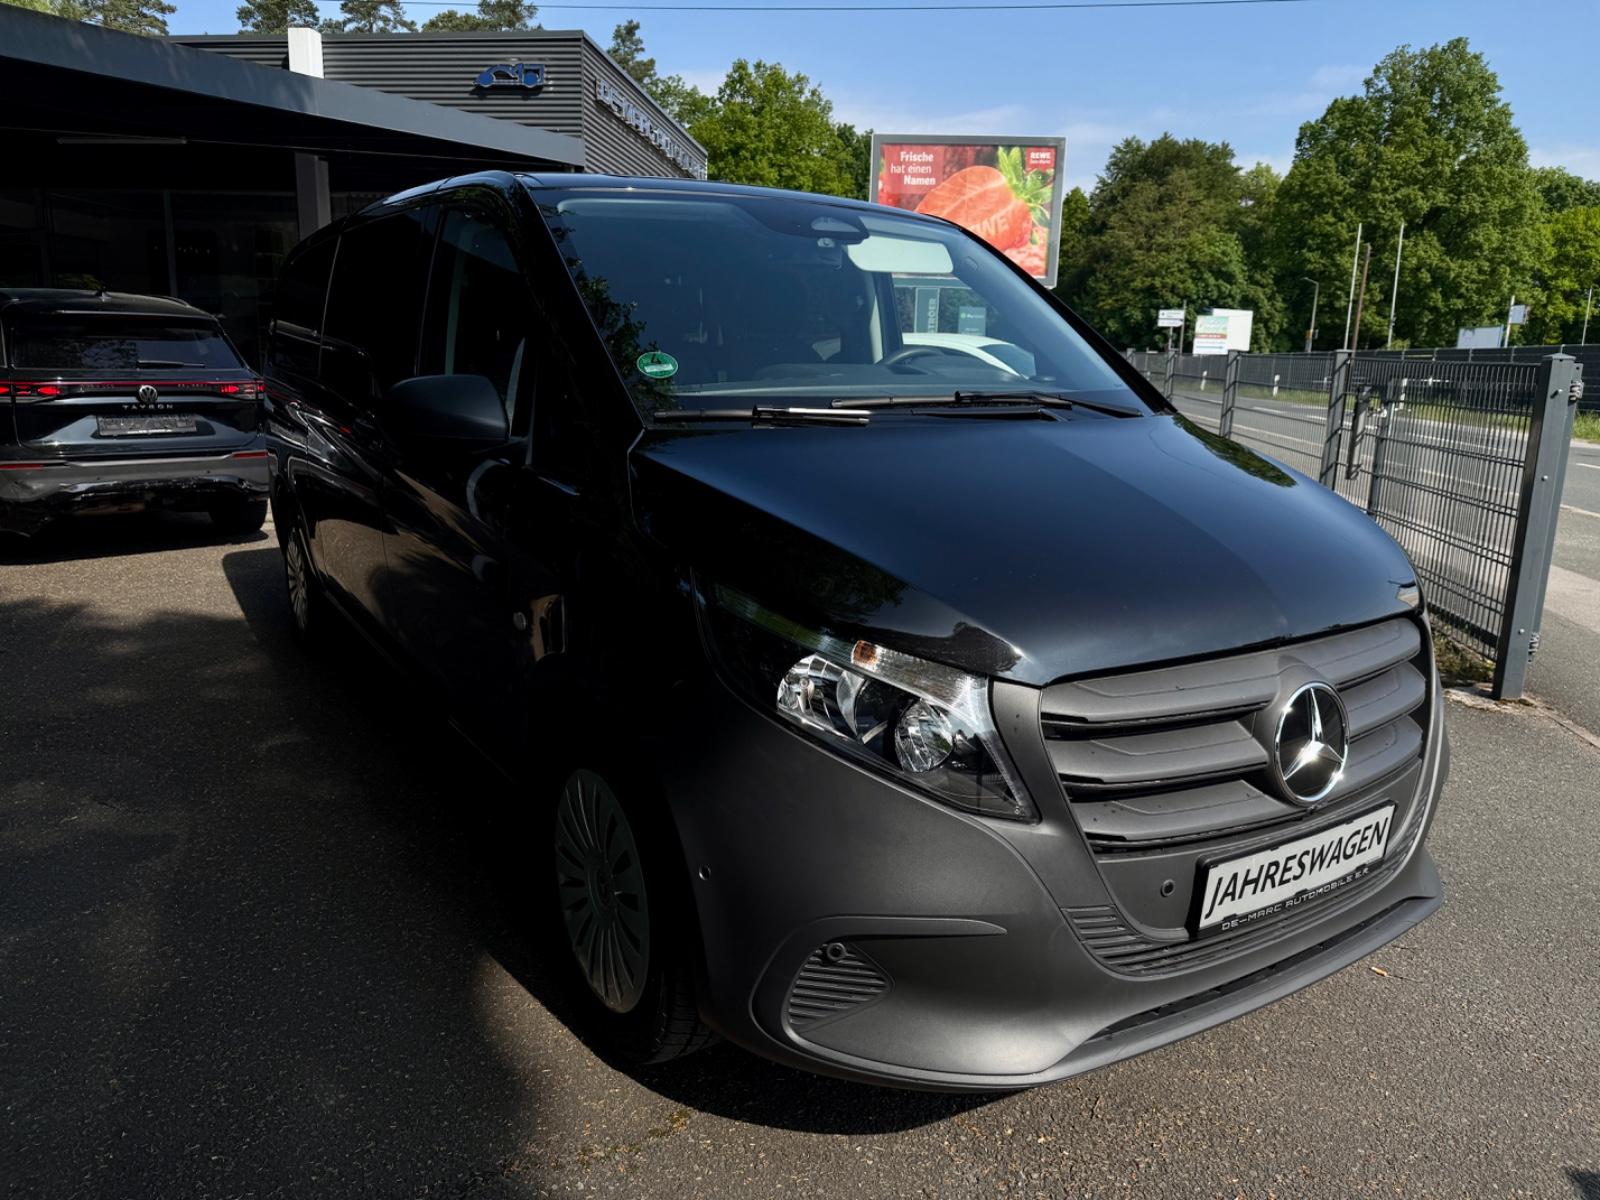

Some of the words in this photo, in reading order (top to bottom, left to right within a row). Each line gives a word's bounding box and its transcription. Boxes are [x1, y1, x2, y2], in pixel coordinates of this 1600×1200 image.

[900, 151, 934, 162] Frische
[890, 162, 905, 174] hat
[908, 163, 932, 174] einen
[903, 174, 936, 186] Namen
[1204, 817, 1389, 920] JAHRESWAGEN
[1221, 903, 1283, 931] DE-MARC
[1285, 876, 1353, 909] AUTOMOBILE
